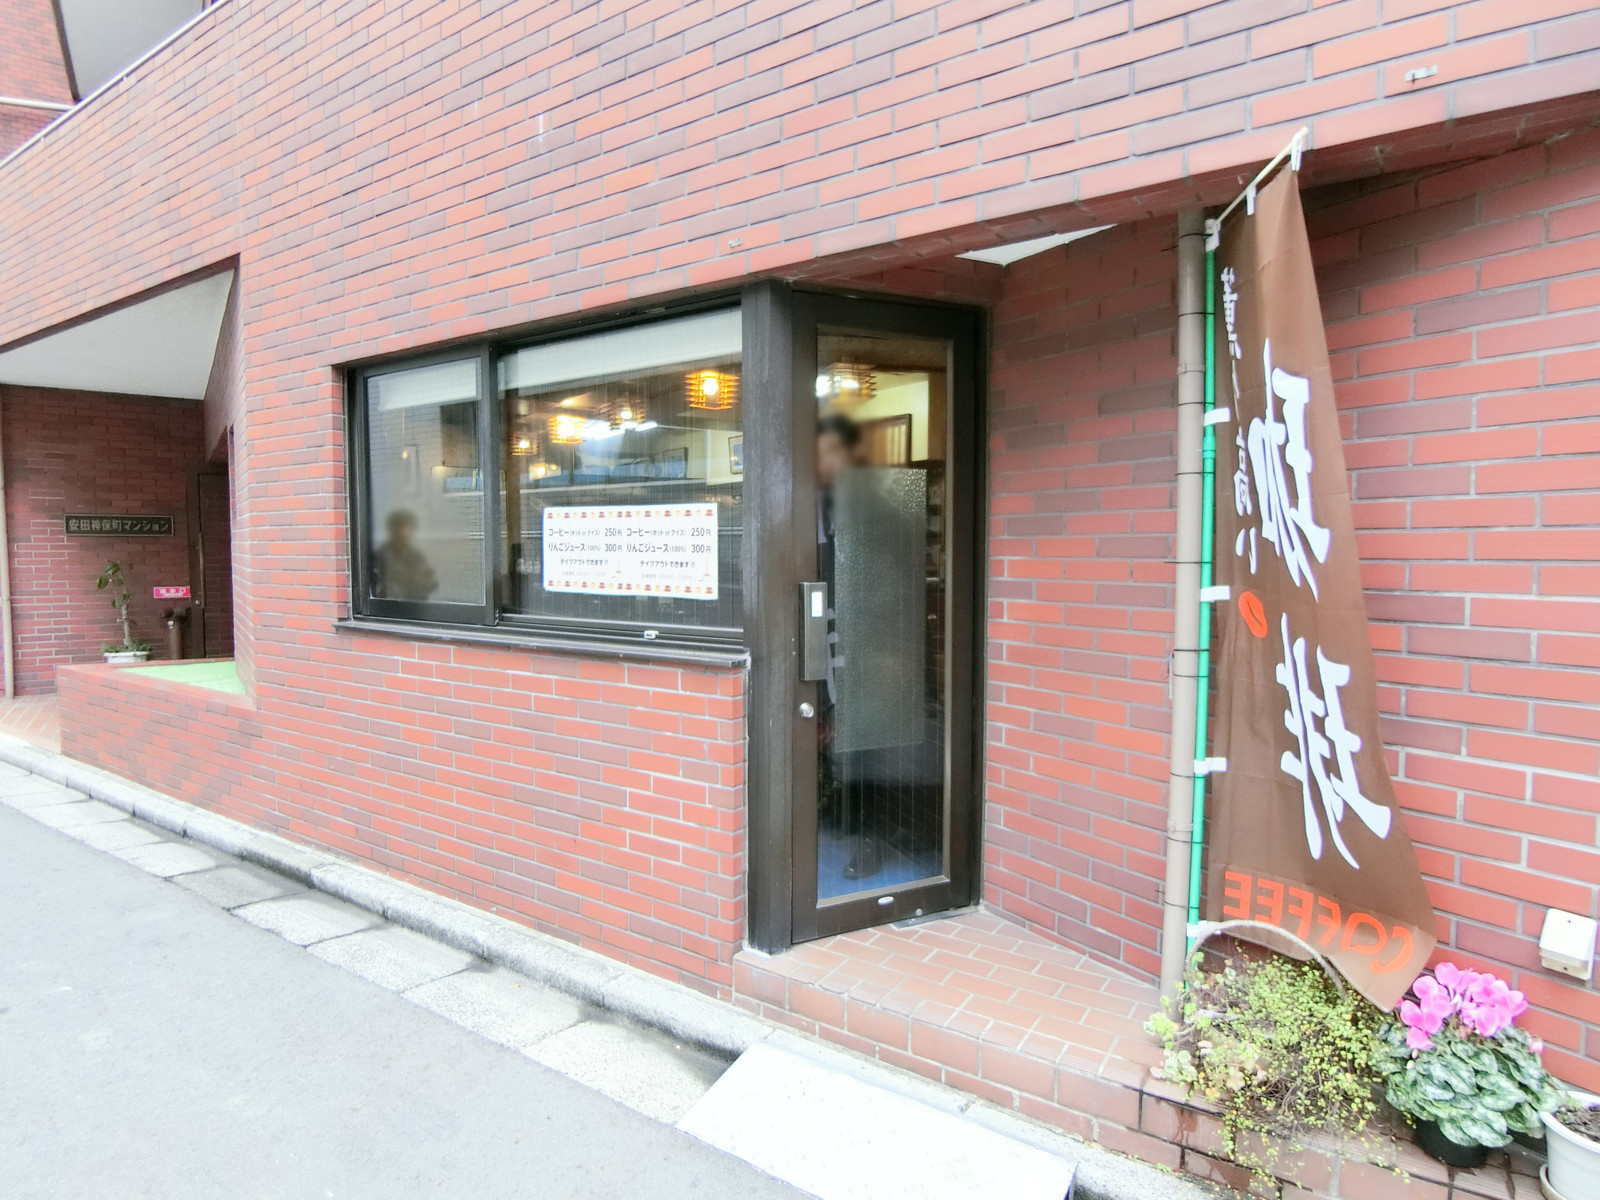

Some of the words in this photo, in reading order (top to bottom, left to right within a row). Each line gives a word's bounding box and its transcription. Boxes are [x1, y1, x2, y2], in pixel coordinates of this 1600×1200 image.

[68, 519, 169, 532] 安田神保町マンション
